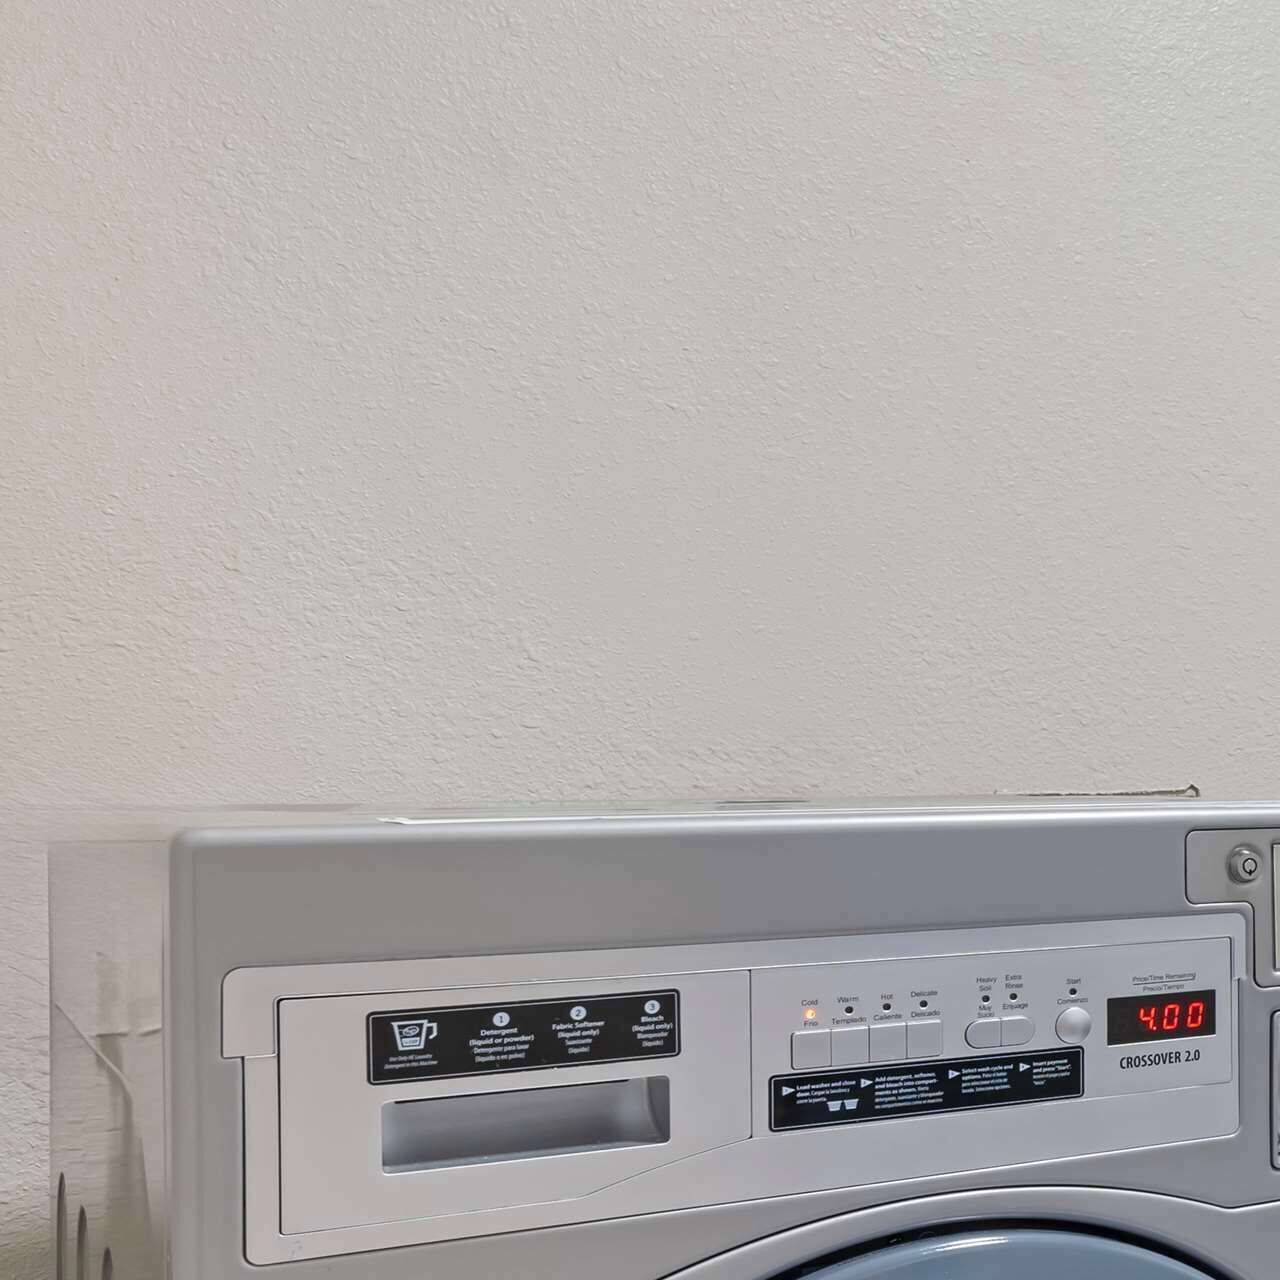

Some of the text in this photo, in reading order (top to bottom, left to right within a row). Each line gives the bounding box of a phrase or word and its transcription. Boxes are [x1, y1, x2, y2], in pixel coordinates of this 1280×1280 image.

[976, 976, 998, 985] Heavy
[1004, 973, 1023, 981] Extra
[800, 999, 818, 1007] Cold
[836, 996, 859, 1004] Warm
[872, 1013, 903, 1022] Caliente
[1138, 1002, 1205, 1031] 4.00
[552, 1022, 574, 1031] Fabric
[480, 1027, 518, 1037] Detergent
[469, 1037, 494, 1047] (liquid
[503, 1034, 535, 1044] powder)
[1119, 1048, 1201, 1070] CROSSOVER 2.0
